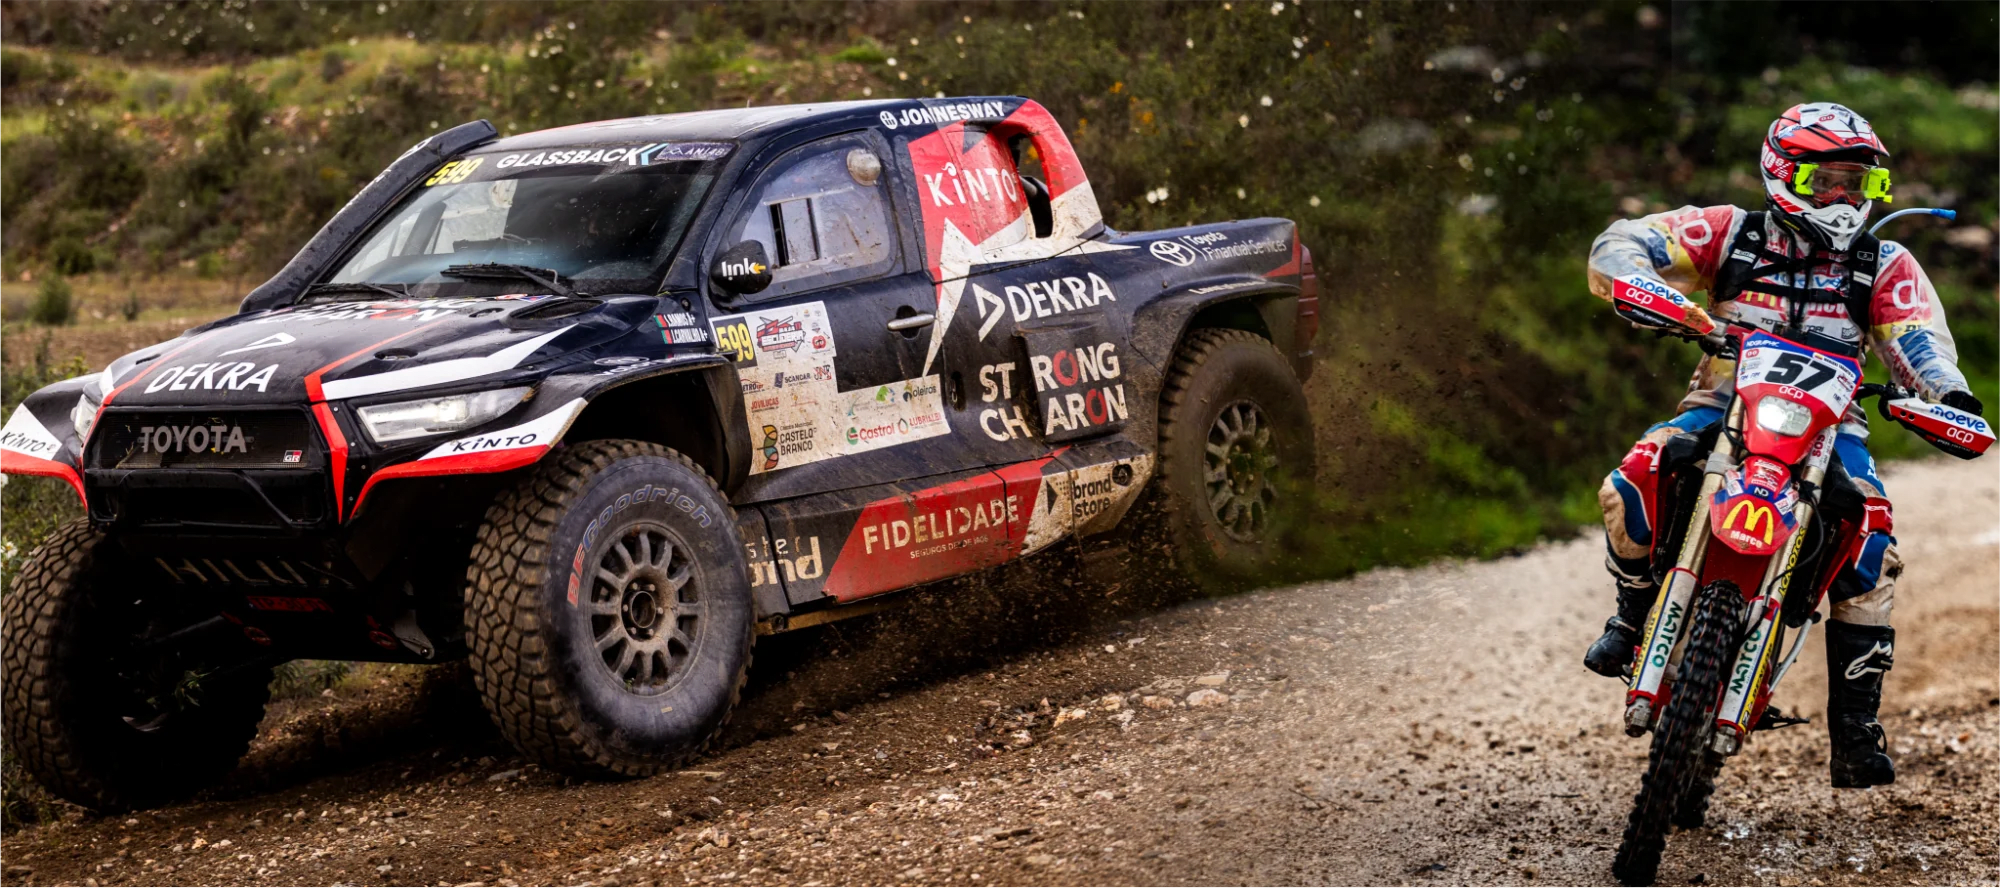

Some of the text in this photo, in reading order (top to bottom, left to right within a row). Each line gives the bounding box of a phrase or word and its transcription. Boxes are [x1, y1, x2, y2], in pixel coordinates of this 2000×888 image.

[899, 101, 1005, 127] JONNESWAY
[424, 158, 484, 187] 599
[1184, 231, 1228, 246] Toyota
[1202, 238, 1287, 262] Financial Services
[721, 261, 757, 280] link
[1004, 272, 1116, 323] DEKRA
[1625, 287, 1653, 305] acp
[1630, 277, 1685, 305] moeve
[716, 323, 755, 363] 599
[144, 363, 279, 394] DEKRA
[1764, 352, 1837, 392] 57
[912, 385, 937, 398] oleiros
[1778, 385, 1805, 400] acp
[1930, 405, 1986, 433] moeve
[140, 424, 248, 453] TOYOTA
[780, 427, 814, 444] CASTELO
[859, 422, 896, 441] Castrol
[1946, 427, 1974, 443] acp
[780, 440, 813, 456] BRANCO
[1073, 474, 1112, 499] brand
[1074, 497, 1111, 518] store
[863, 494, 1019, 555] FIDELIDADE
[1730, 530, 1763, 549] Marco
[910, 545, 948, 559] SEGUROS
[1652, 600, 1684, 668] Marco
